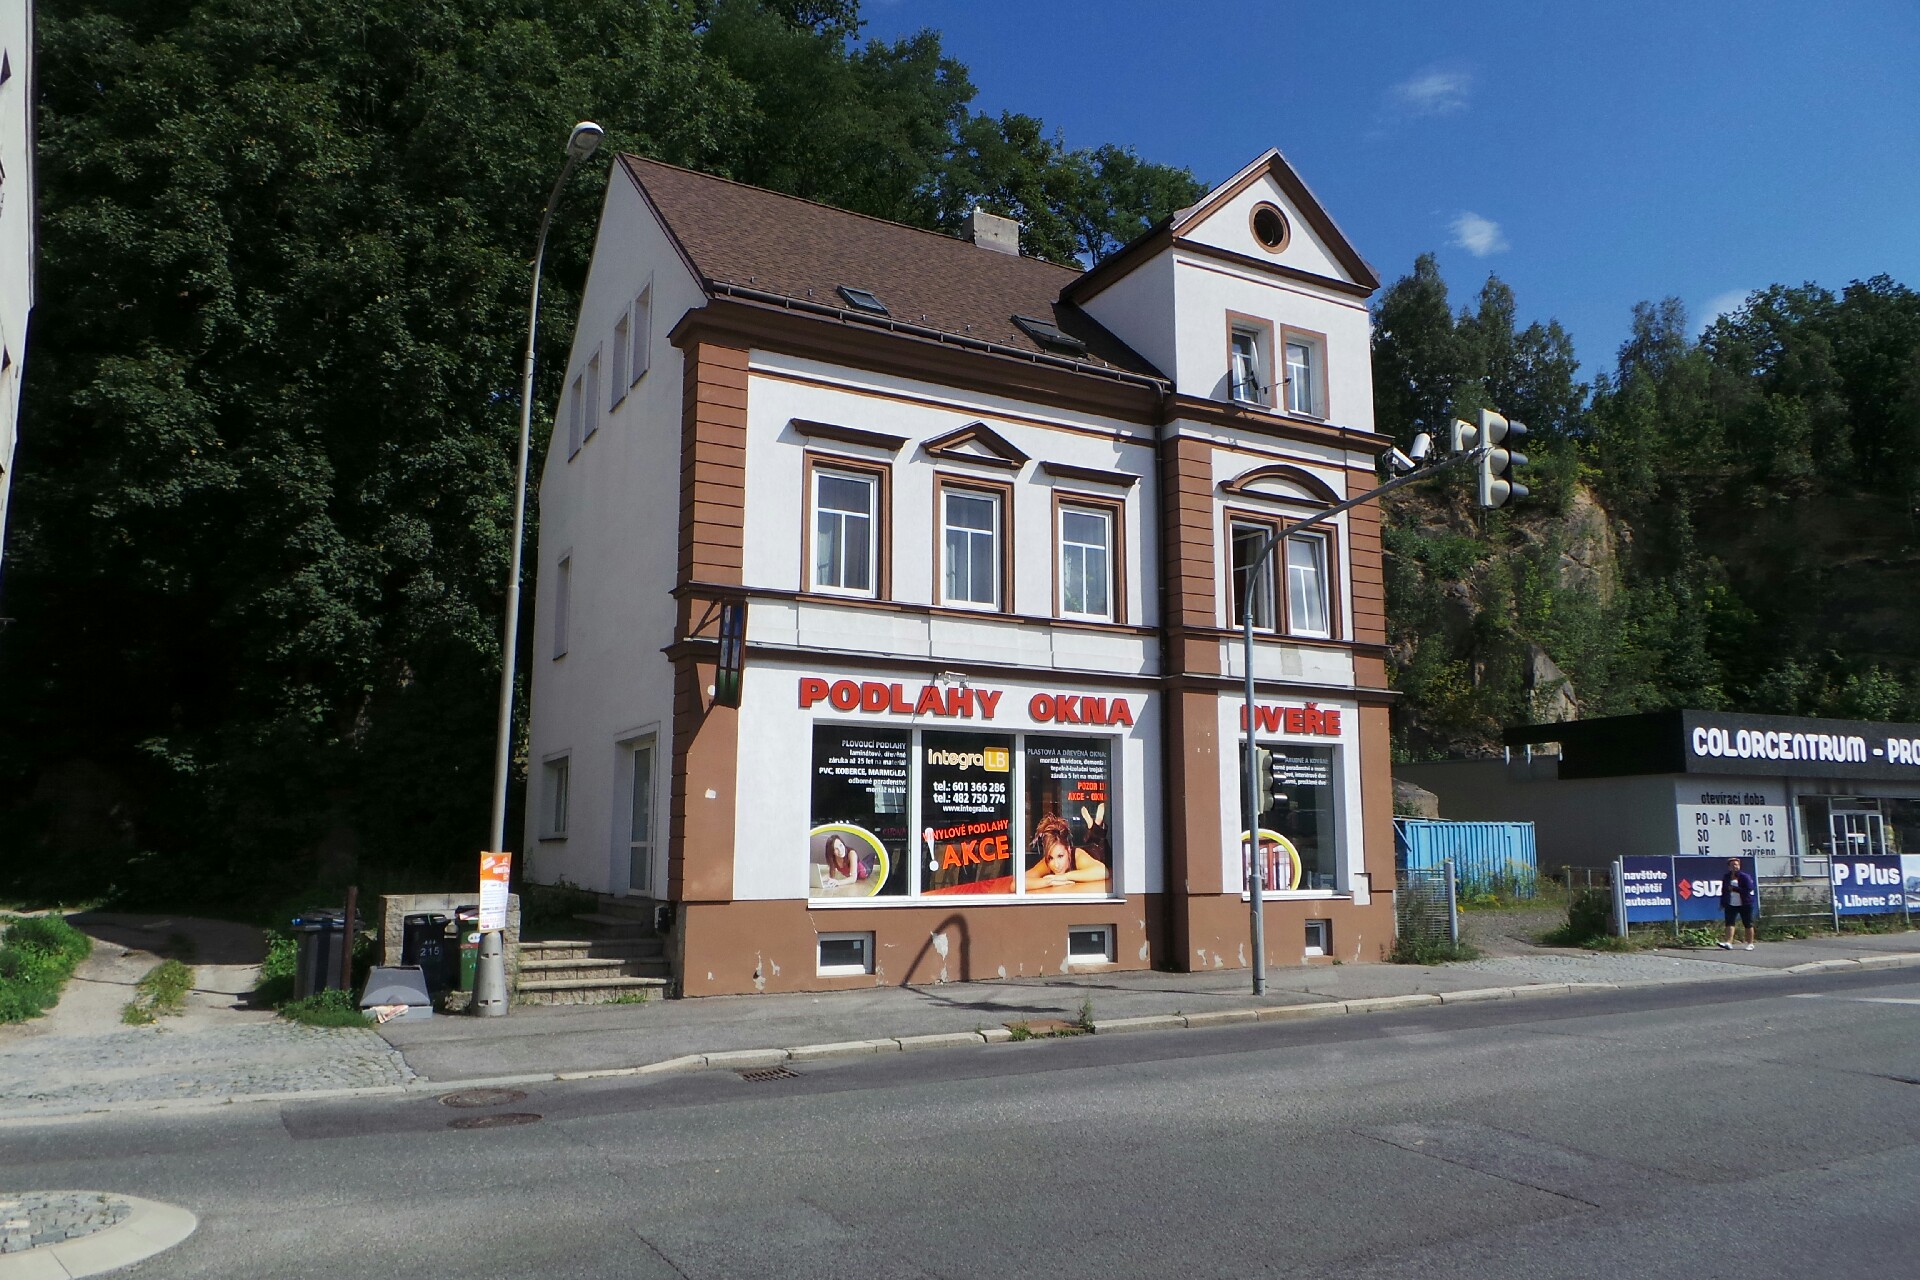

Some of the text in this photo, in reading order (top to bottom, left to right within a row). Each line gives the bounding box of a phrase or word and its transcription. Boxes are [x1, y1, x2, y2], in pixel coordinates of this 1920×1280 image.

[798, 677, 1134, 725] PODLAHY OKNA
[1242, 702, 1341, 735] DVEŘE
[842, 740, 875, 748] PLOVOUCÍ
[1693, 727, 1866, 762] COLORCENTRUM
[928, 748, 984, 770] integra
[819, 767, 834, 775] PVC,
[835, 767, 867, 776] KOBERCE,
[848, 777, 872, 785] odborné
[933, 781, 1006, 793] tel.: 601 366 286
[1077, 781, 1098, 790] POZOR
[933, 792, 1006, 804] tel.: 482 750 774
[1067, 792, 1085, 801] AKCE
[1701, 791, 1766, 805] otevírací doba
[942, 804, 995, 813] www.integralb.cz
[1696, 813, 1708, 825] PO
[1718, 809, 1731, 825] PÁ
[1740, 813, 1751, 826] 07
[1762, 813, 1774, 826] 18
[967, 820, 1009, 835] PODLAHY
[1697, 829, 1709, 842] SO
[1741, 829, 1752, 842] 08
[1764, 830, 1775, 843] 12
[942, 835, 1010, 870] AKCE
[1742, 846, 1776, 858] zavřeno
[1623, 870, 1667, 880] navštivte
[1854, 863, 1900, 885] Plus
[1624, 883, 1663, 895] největší
[1625, 897, 1672, 906] autosalon
[1844, 894, 1885, 907] Liberec
[1888, 893, 1903, 906] 23
[420, 946, 440, 957] 215
